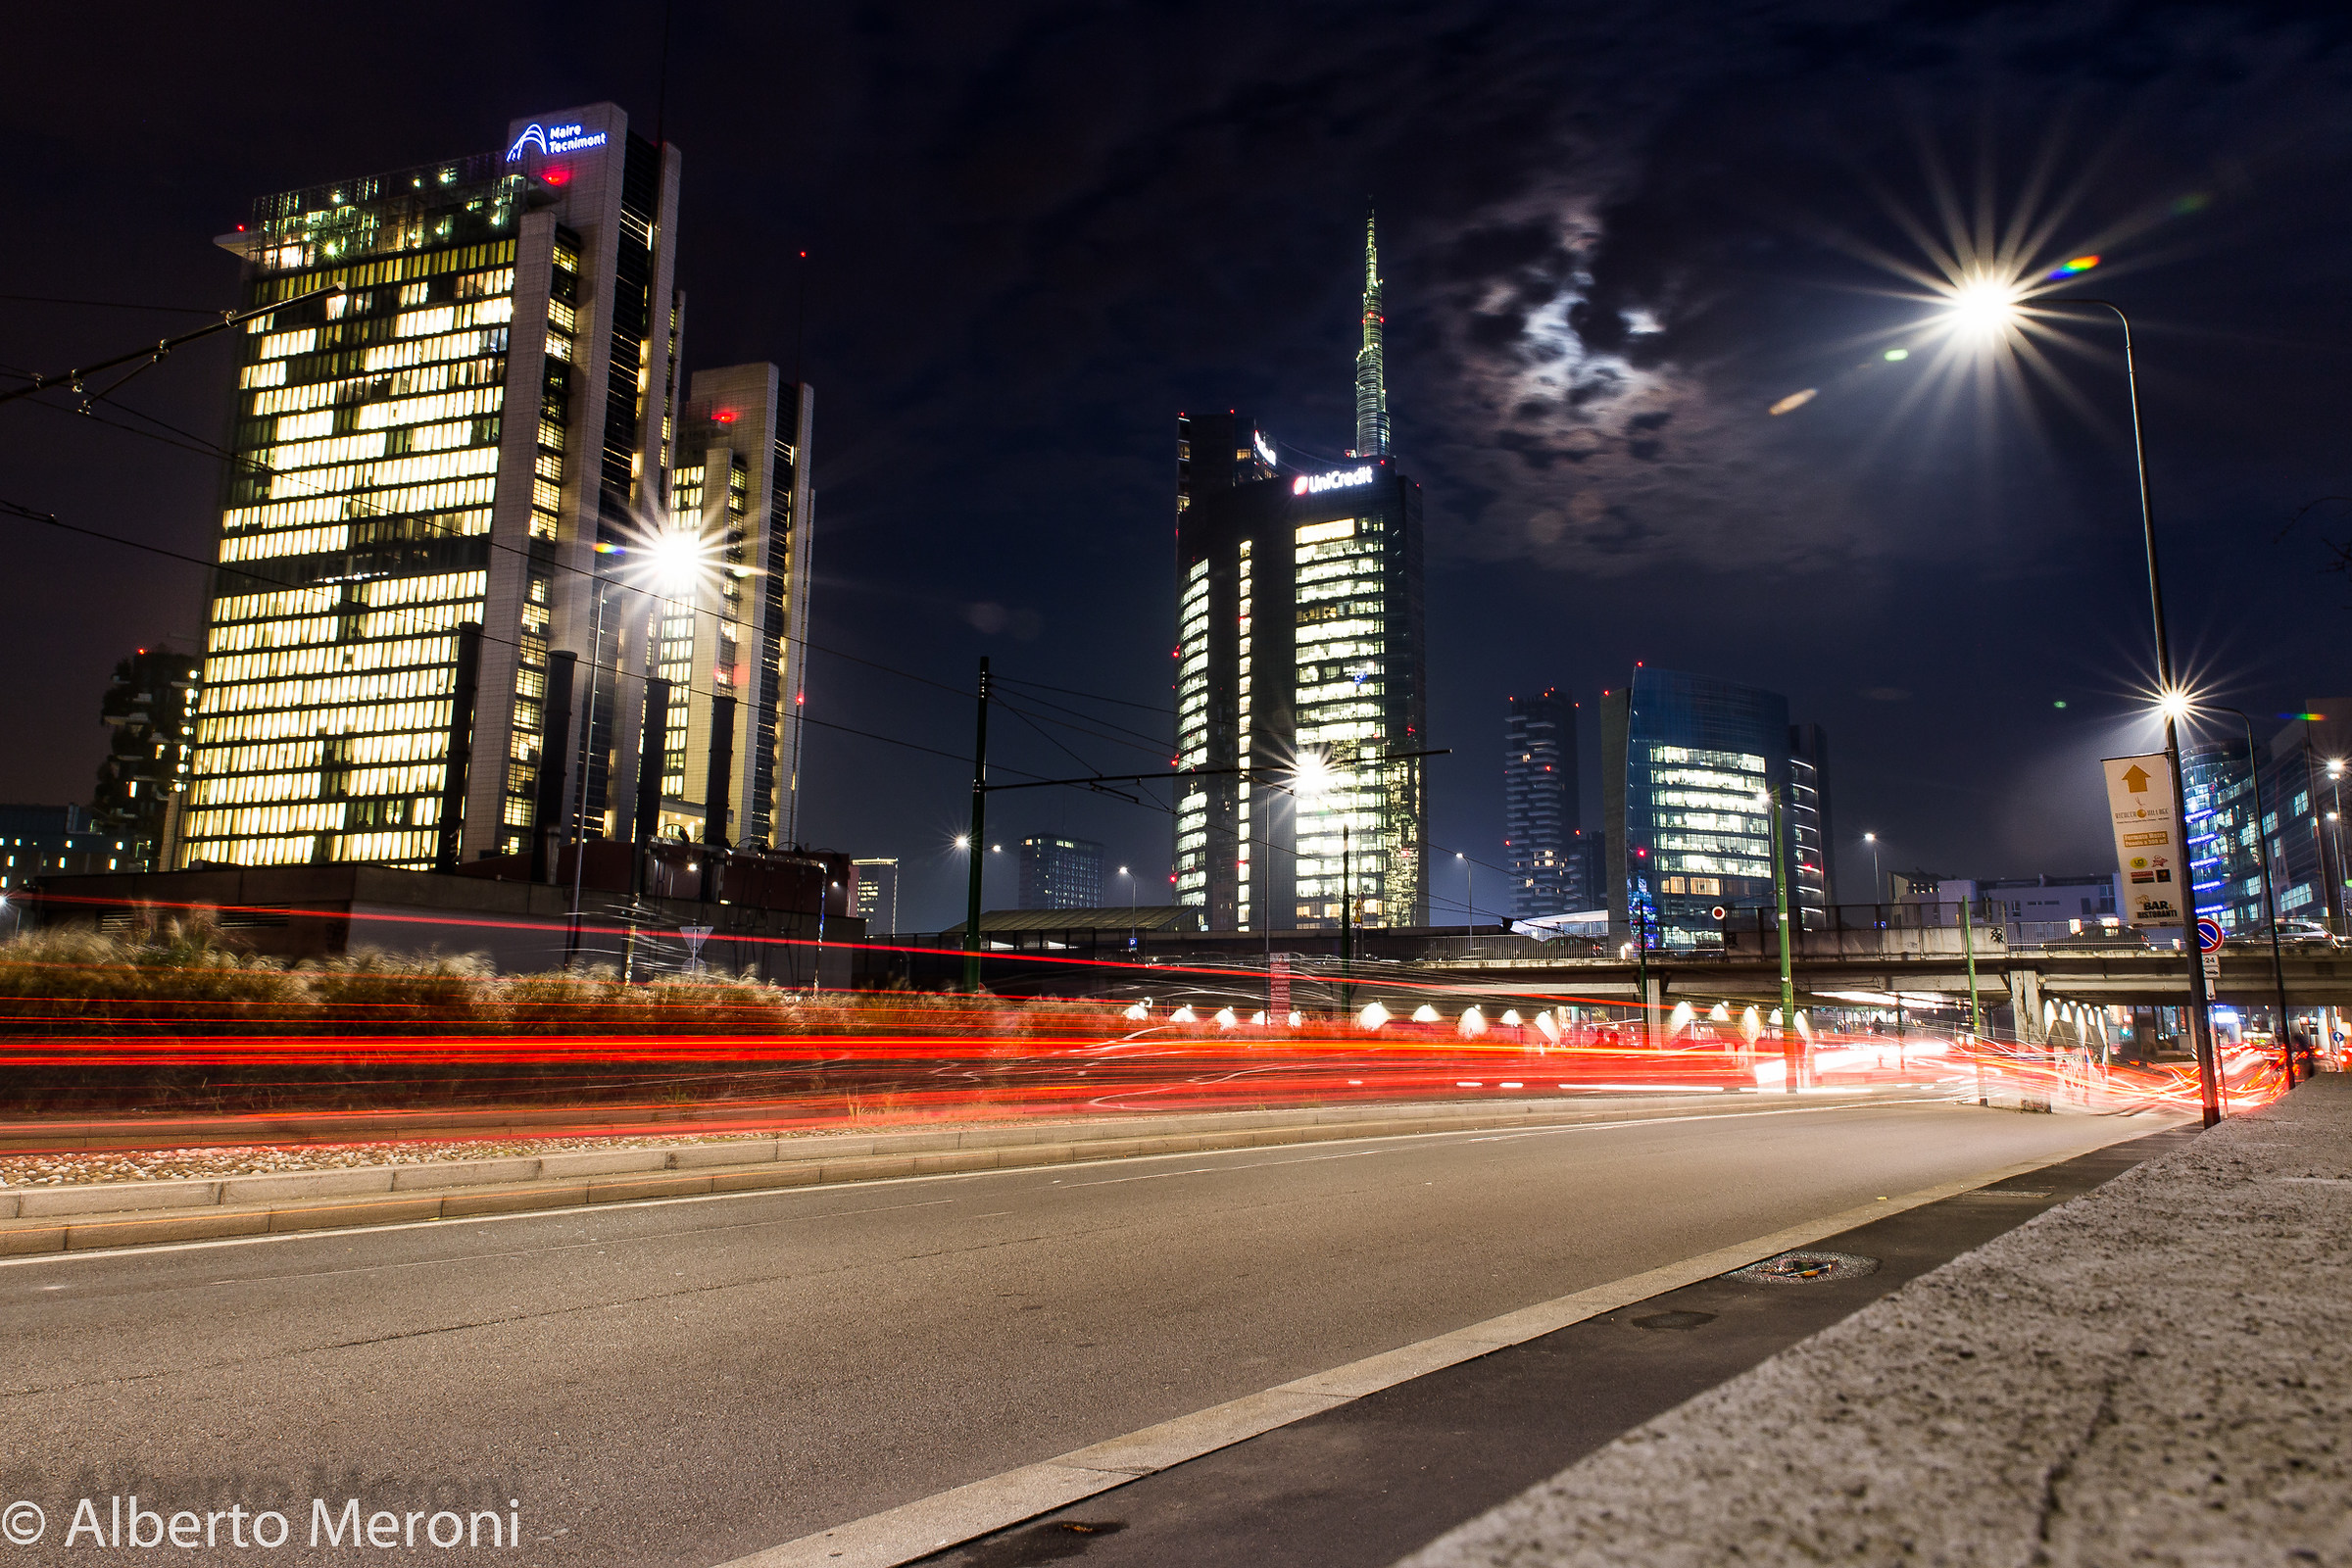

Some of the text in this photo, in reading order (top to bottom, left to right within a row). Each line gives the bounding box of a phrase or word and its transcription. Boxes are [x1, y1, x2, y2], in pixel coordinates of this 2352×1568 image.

[550, 124, 582, 140] Maire
[549, 132, 607, 154] Tecnimont
[1308, 466, 1373, 492] UniCredit
[2143, 900, 2169, 910] BAR
[2136, 909, 2178, 919] RISTORANTI
